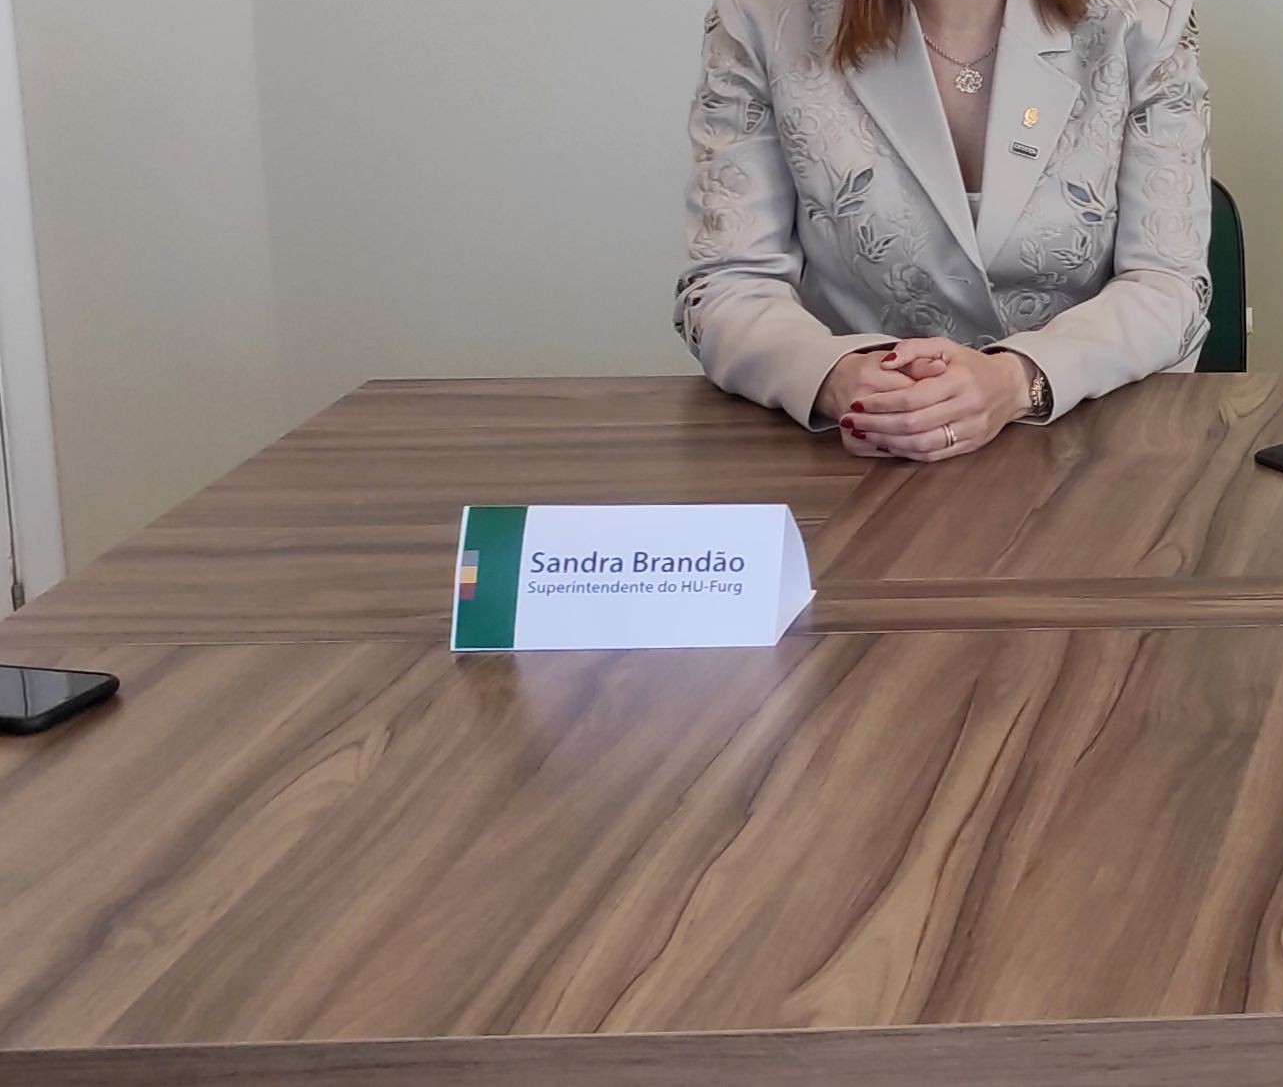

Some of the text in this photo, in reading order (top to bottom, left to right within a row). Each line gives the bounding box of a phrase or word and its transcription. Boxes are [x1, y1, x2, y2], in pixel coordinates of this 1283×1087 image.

[530, 551, 745, 575] Sandra Brandão
[527, 580, 743, 596] Superintendente do HU-Furg
